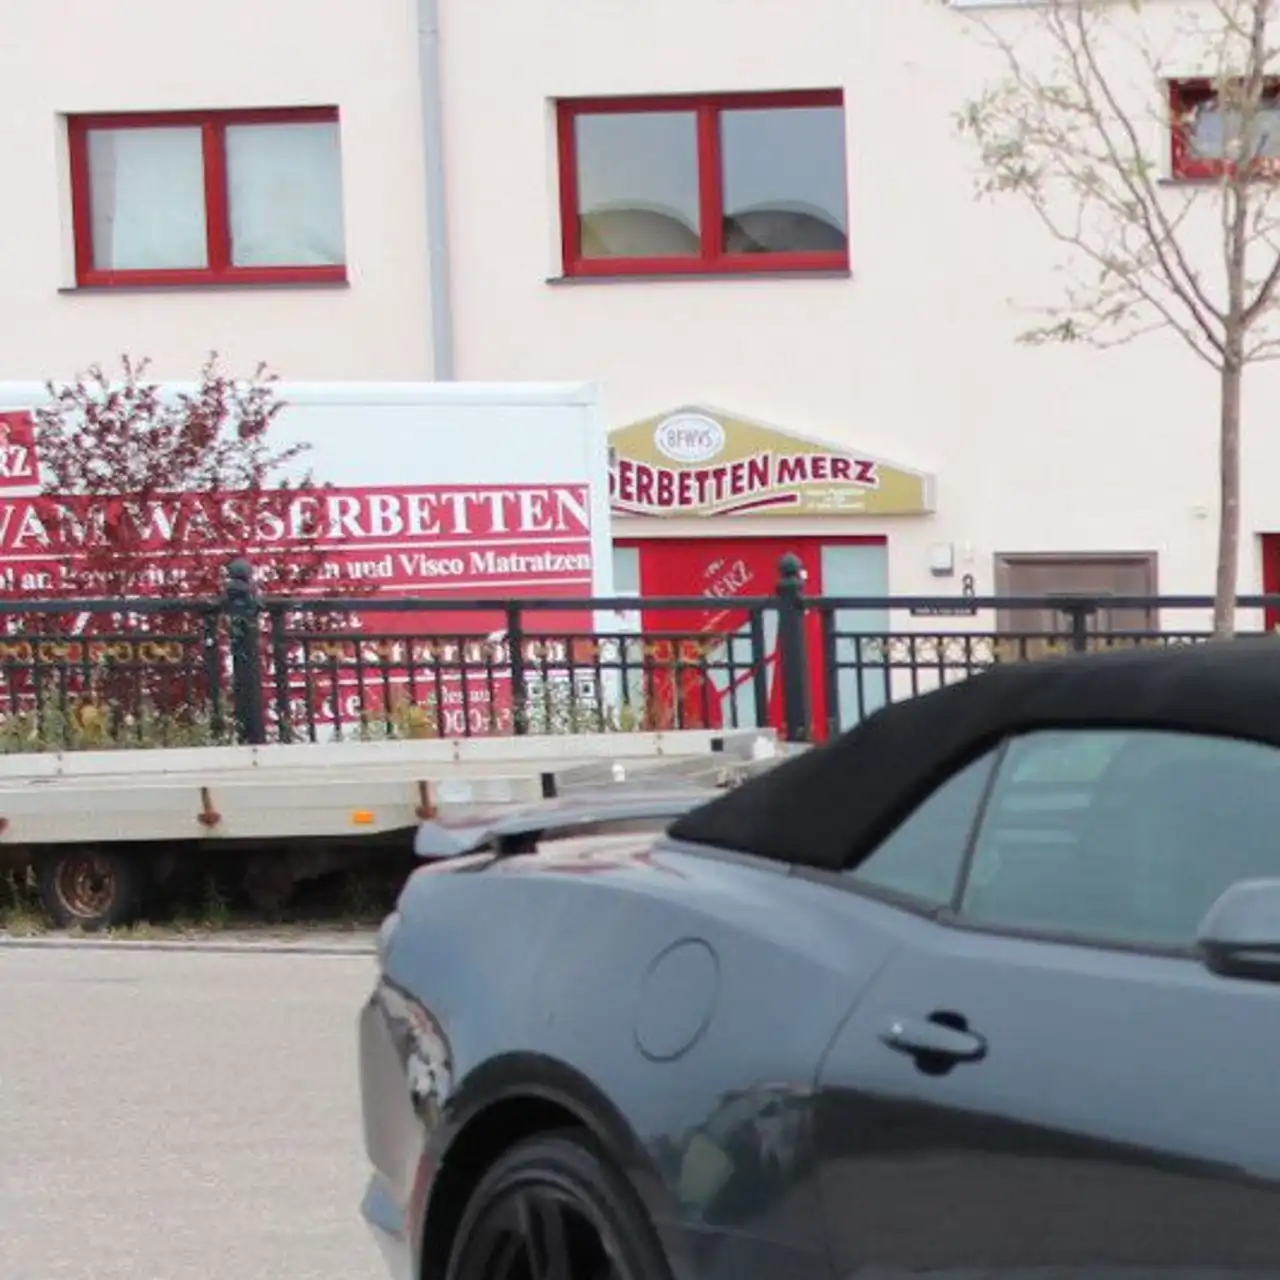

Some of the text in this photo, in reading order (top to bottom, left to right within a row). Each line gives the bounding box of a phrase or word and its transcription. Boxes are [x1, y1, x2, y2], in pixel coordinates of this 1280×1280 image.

[777, 456, 876, 483] MERZ
[346, 554, 393, 579] und
[399, 552, 464, 577] Visco
[469, 550, 591, 575] Matratzen
